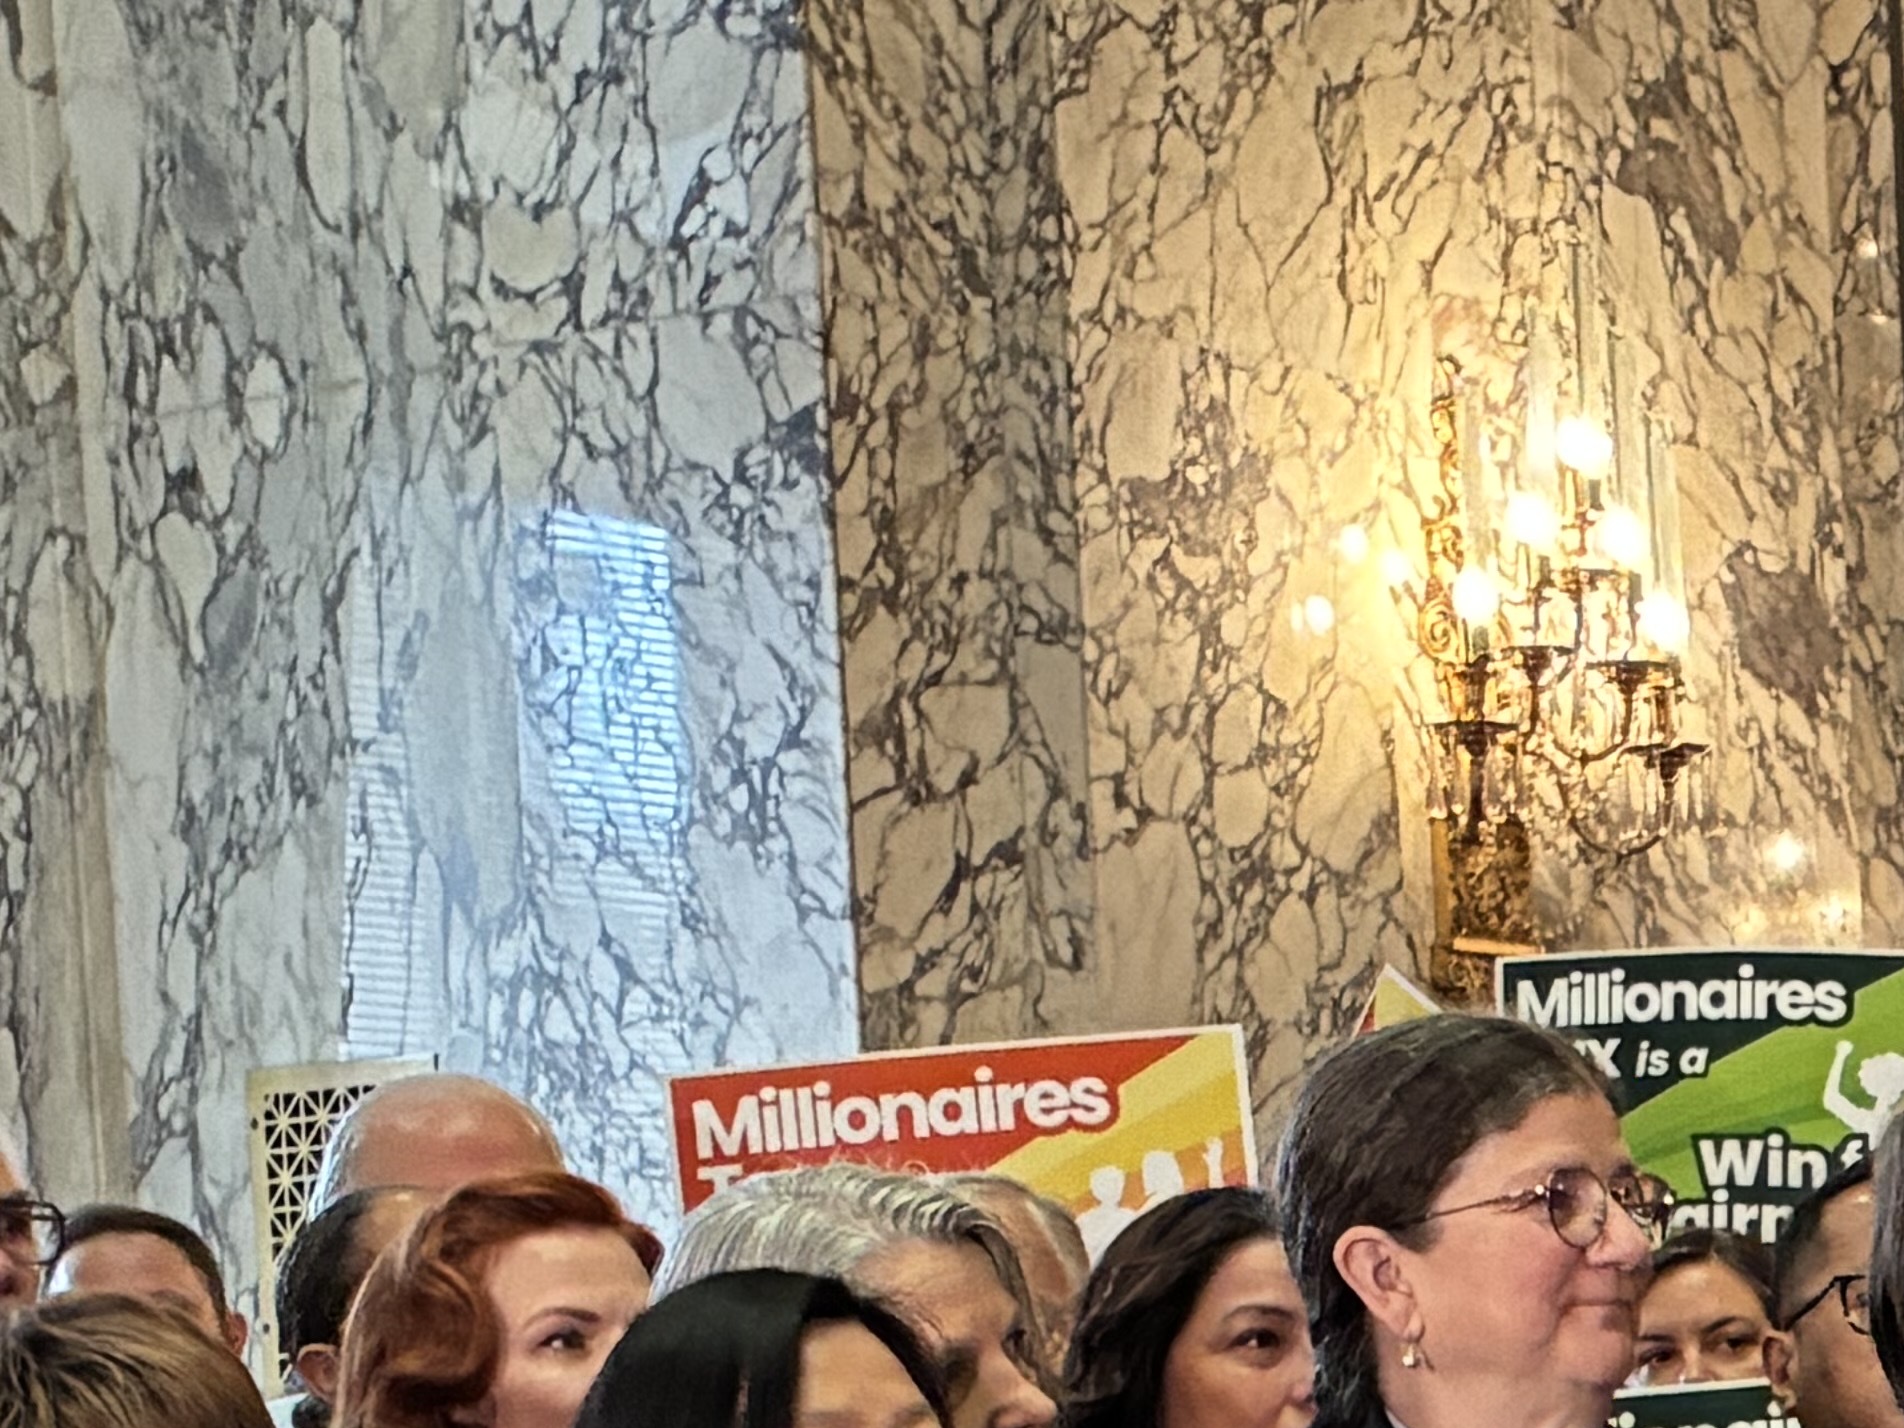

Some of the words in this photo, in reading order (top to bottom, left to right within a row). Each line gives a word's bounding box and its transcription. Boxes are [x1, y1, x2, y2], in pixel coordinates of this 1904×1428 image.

[1516, 963, 1848, 1028] Millionaires
[1634, 1040, 1669, 1077] is
[1679, 1047, 1709, 1075] a
[691, 1065, 1111, 1160] Millionaires
[1698, 1133, 1828, 1189] Win
